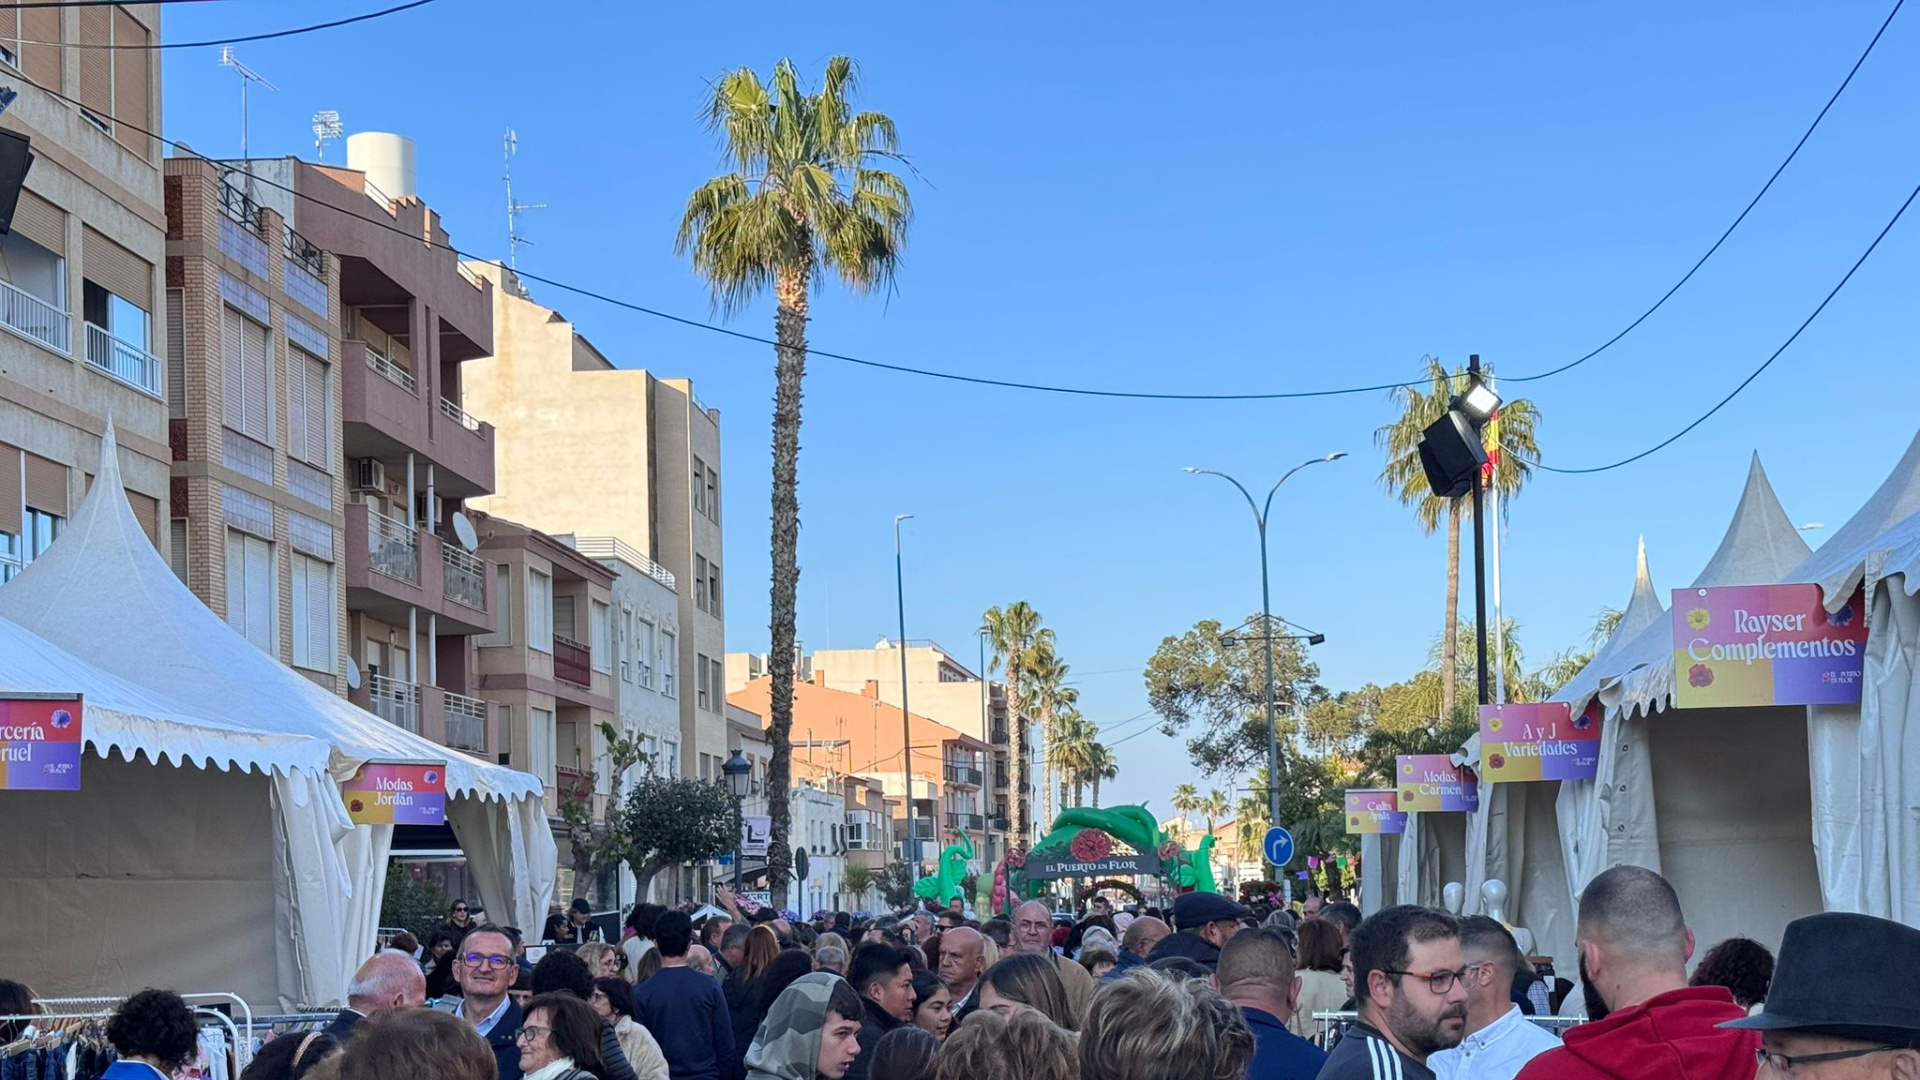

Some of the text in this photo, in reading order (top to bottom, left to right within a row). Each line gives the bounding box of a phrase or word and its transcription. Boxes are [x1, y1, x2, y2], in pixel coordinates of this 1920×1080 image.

[1734, 609, 1806, 639] Rayser
[1688, 636, 1856, 665] Complementos
[1522, 722, 1557, 743] A y J
[1503, 740, 1578, 758] Variedades
[1423, 770, 1457, 783] Modas
[375, 777, 413, 791] Modas
[1419, 783, 1462, 796] Carmen
[374, 792, 413, 806] Jordán
[1057, 863, 1096, 872] PUERTO
[1109, 860, 1139, 870] FLOR
